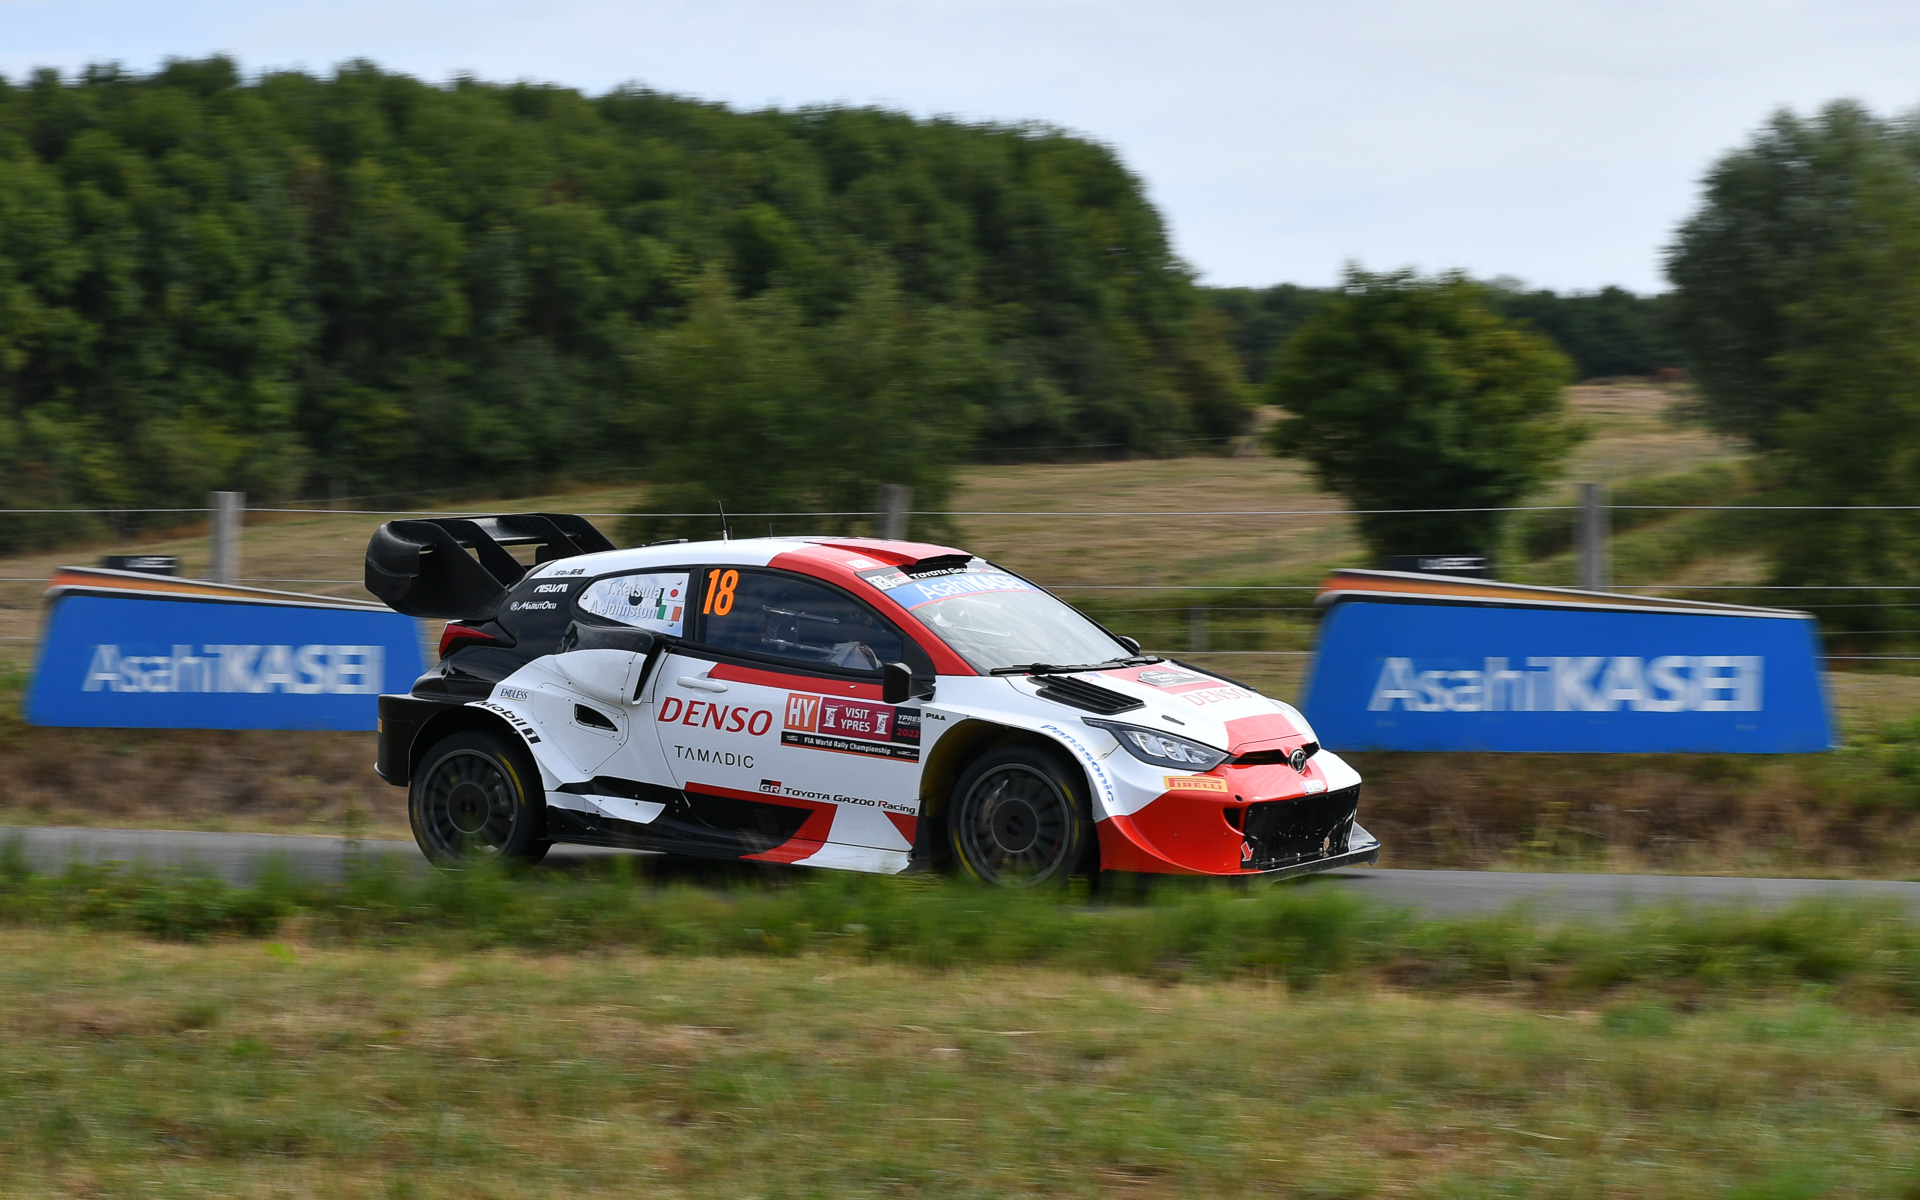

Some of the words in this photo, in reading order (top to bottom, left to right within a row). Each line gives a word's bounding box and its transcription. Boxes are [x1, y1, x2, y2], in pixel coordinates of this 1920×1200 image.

[870, 577, 892, 588] 18
[910, 569, 950, 579] TOYOTA
[703, 568, 739, 616] 18
[82, 644, 385, 694] AsahiKASEI
[1367, 655, 1763, 713] AsahiKASEI
[500, 688, 528, 699] ENDLESS
[1181, 688, 1252, 706] DENSO
[475, 701, 528, 727] Mobil
[657, 696, 773, 736] DENSO
[787, 697, 816, 728] HY
[845, 707, 870, 720] VISIT
[898, 714, 922, 723] YPRES
[925, 712, 946, 721] PIAA
[840, 718, 871, 732] YPRES
[896, 728, 919, 738] 2022
[815, 738, 832, 747] World
[833, 740, 849, 750] Rally
[849, 743, 891, 755] Championship
[674, 745, 754, 769] TAMADIC
[1040, 724, 1114, 802] Panasonic
[1168, 778, 1223, 790] PIRELLI
[760, 784, 780, 793] GR
[784, 787, 830, 800] TOYOTA
[833, 794, 875, 807] GAZOO
[878, 800, 916, 815] Racing
